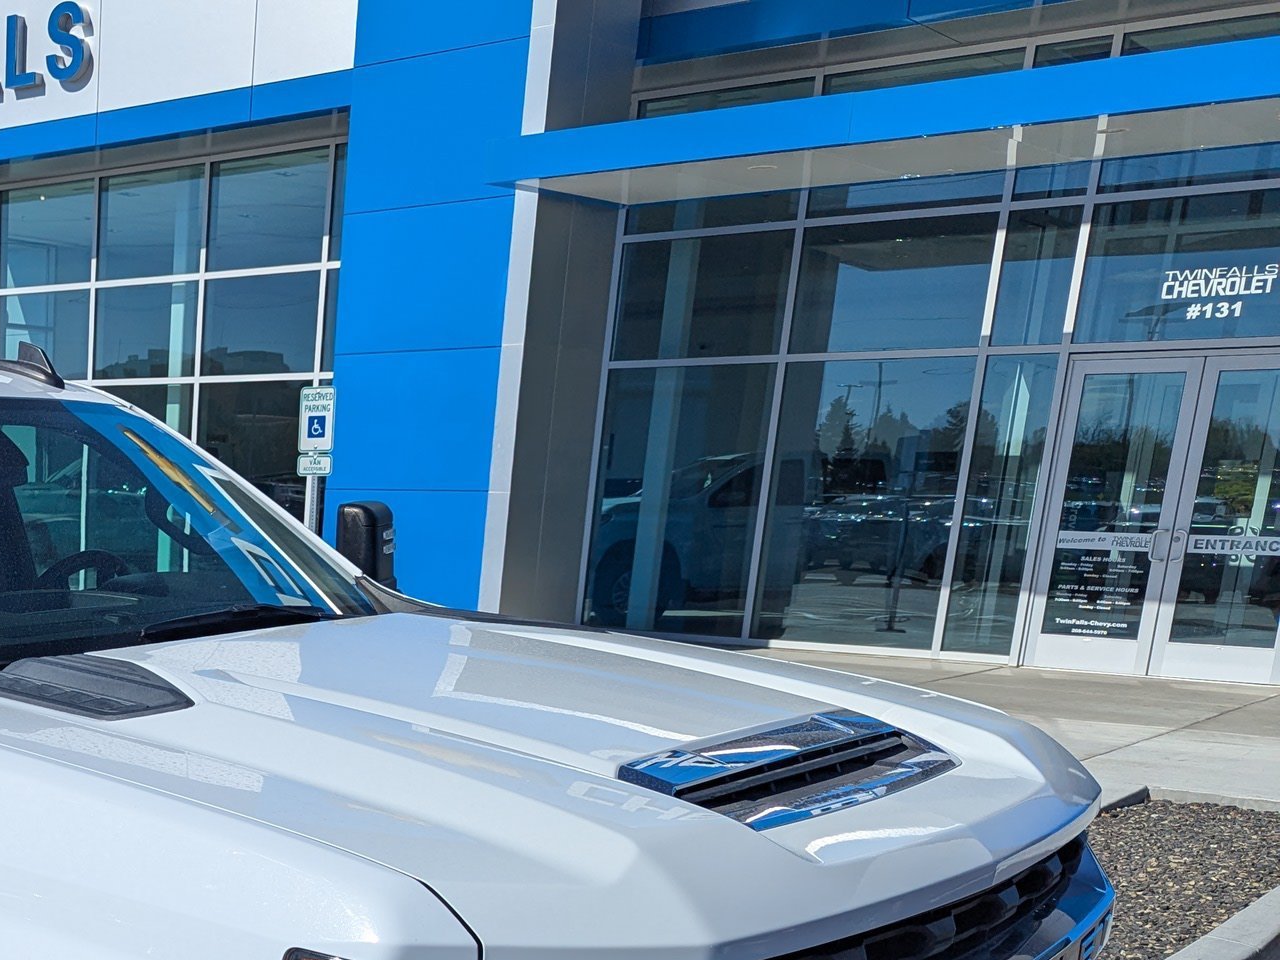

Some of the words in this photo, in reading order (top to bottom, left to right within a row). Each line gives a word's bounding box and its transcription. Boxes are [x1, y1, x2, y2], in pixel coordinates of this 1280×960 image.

[1164, 263, 1279, 282] TWINFALLS
[1161, 274, 1278, 300] CHEVROLET
[1186, 301, 1243, 320] #131
[303, 392, 334, 402] RESERVED
[304, 403, 331, 413] PARKING
[308, 458, 322, 466] VAN
[1055, 617, 1128, 628] TwinFalls-Chevy.com
